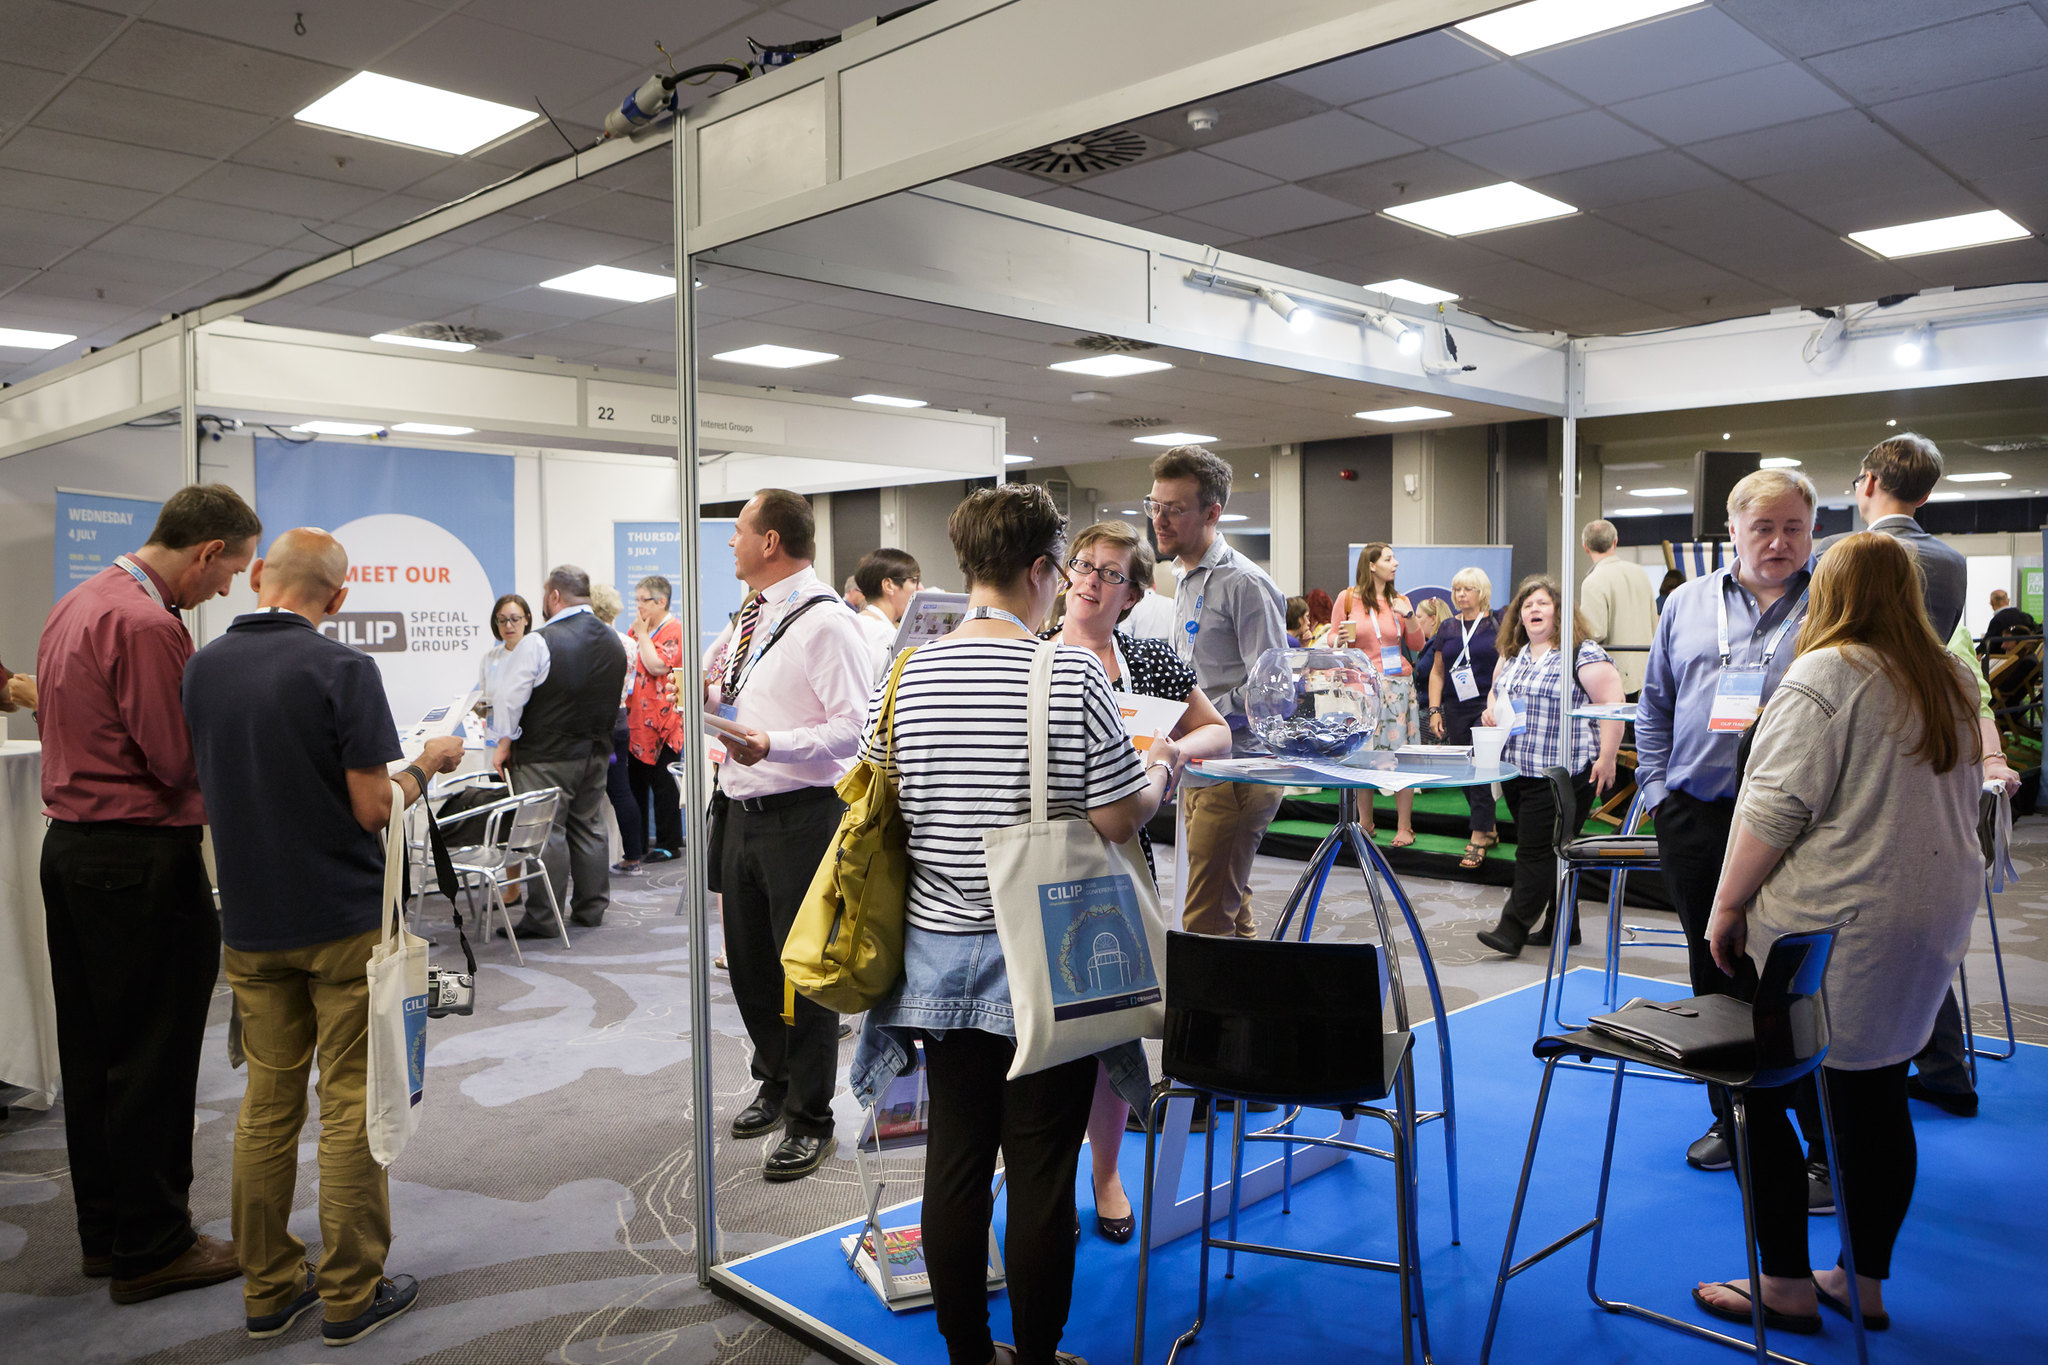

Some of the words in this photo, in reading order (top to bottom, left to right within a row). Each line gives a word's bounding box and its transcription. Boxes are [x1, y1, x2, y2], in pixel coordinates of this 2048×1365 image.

[598, 406, 615, 421] 22
[651, 413, 671, 425] CILIP
[700, 418, 728, 431] Interest
[728, 421, 754, 434] Groups
[69, 508, 133, 525] WEDNESDAY
[69, 529, 75, 539] 4
[76, 529, 97, 542] JULY
[628, 532, 681, 543] THURSDA
[628, 547, 633, 556] 5
[634, 547, 657, 557] JULY
[405, 566, 451, 583] OUR
[411, 611, 469, 623] SPECIAL
[317, 620, 397, 646] CILIP
[411, 625, 481, 638] INTEREST
[411, 639, 469, 652] GROUPS
[1048, 885, 1083, 900] CILIP
[405, 996, 428, 1012] CILI
